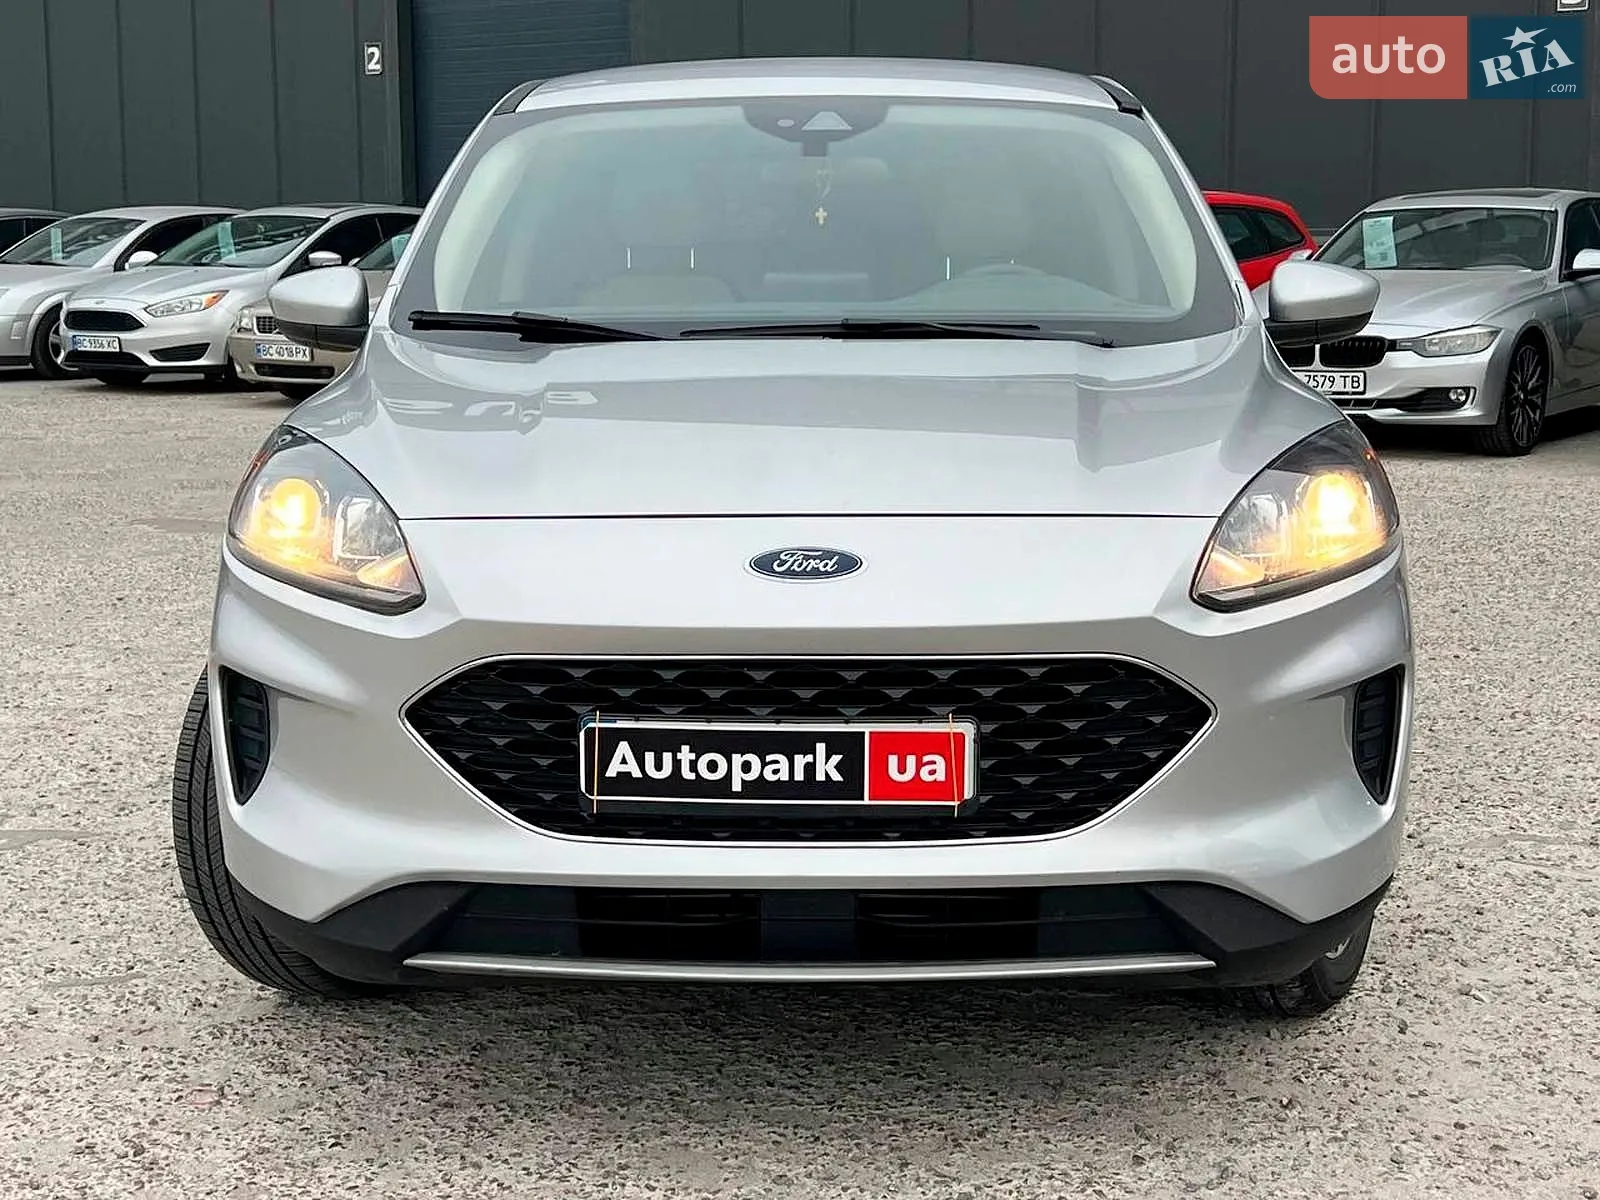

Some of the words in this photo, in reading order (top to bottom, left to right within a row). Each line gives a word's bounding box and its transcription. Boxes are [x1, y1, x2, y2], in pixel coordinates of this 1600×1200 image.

[367, 46, 381, 70] 2
[1304, 374, 1336, 389] 7579
[1339, 375, 1361, 389] TB
[773, 550, 839, 572] Ford
[605, 740, 844, 792] Autopark
[888, 752, 946, 782] ua
